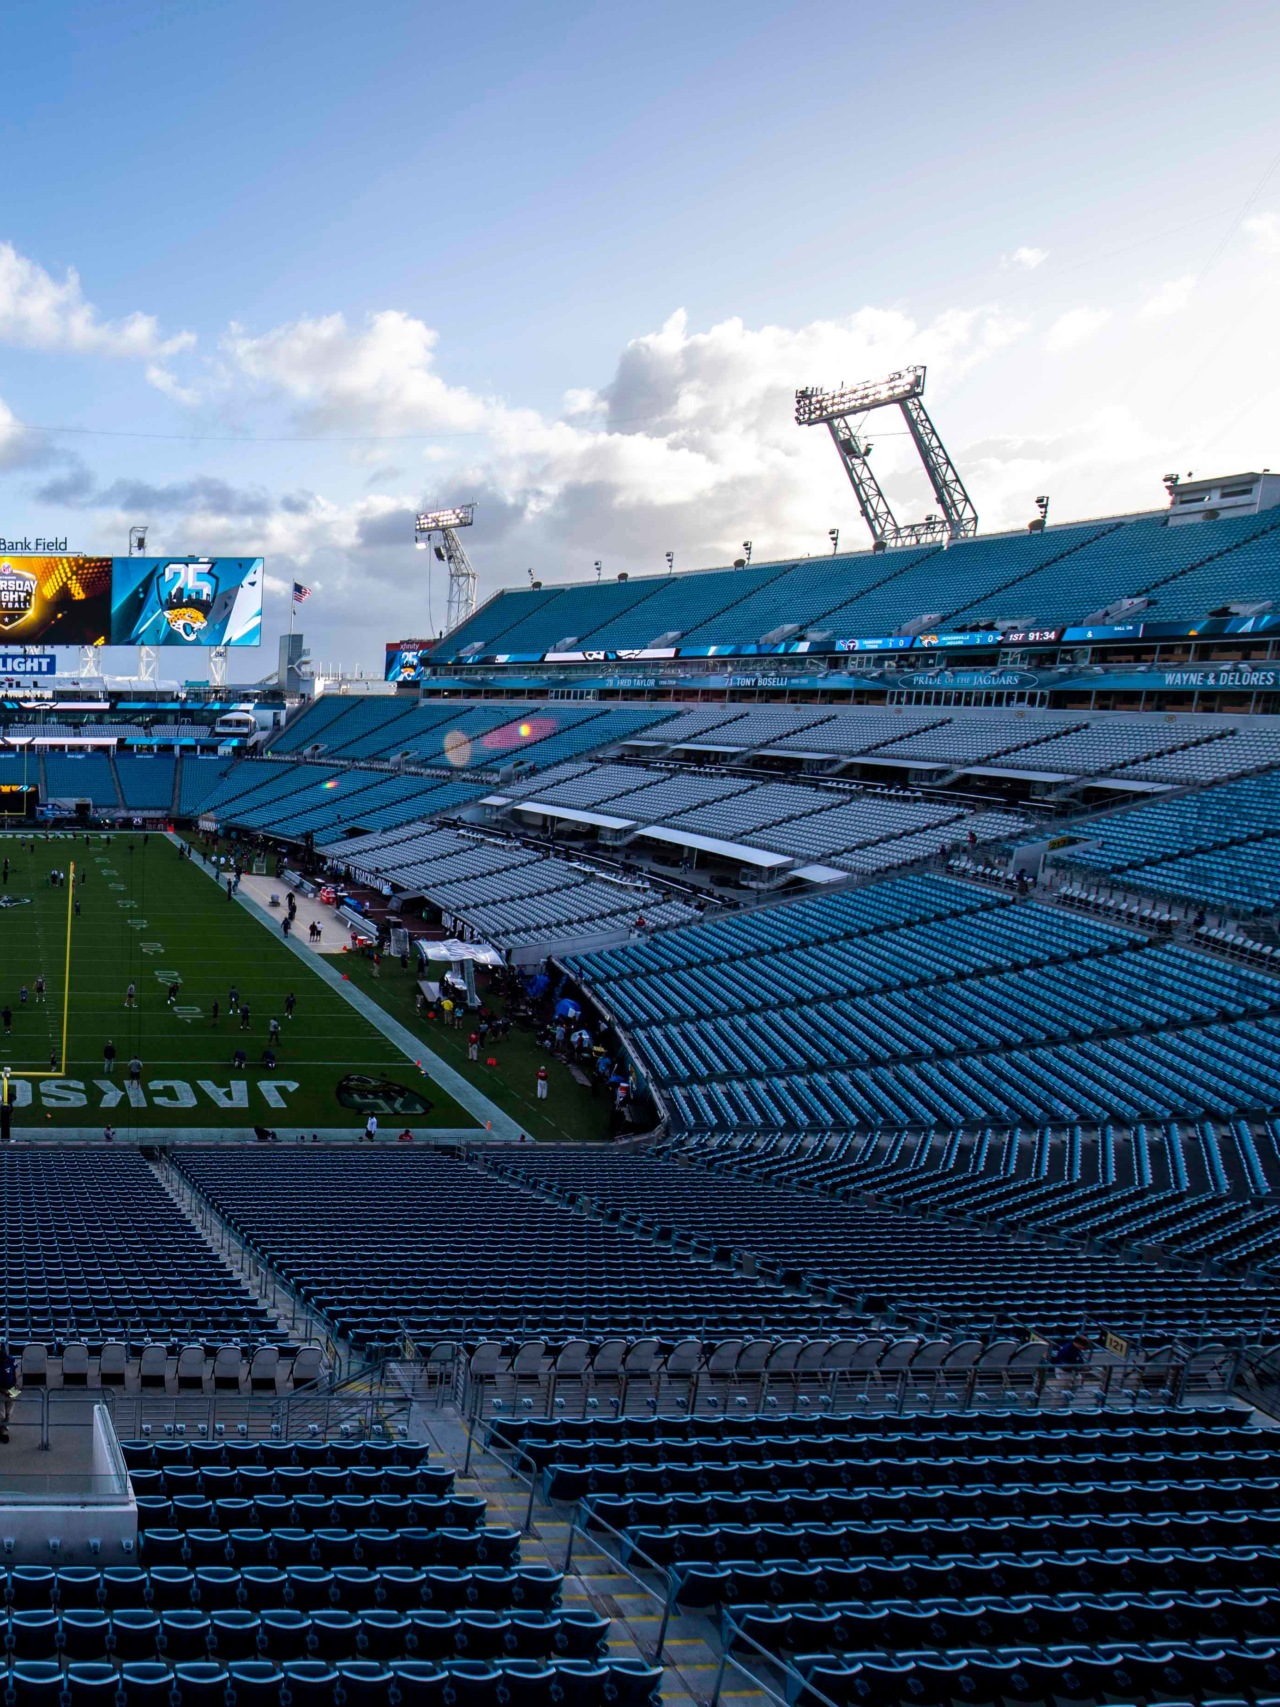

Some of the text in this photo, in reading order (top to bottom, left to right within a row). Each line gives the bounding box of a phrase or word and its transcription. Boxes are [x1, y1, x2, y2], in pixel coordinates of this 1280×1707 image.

[35, 537, 67, 551] Field
[165, 563, 213, 603] 25
[987, 634, 994, 642] 0
[1009, 631, 1056, 641] 1ST 91:34
[400, 643, 420, 651] xfinity
[898, 639, 904, 647] 0
[606, 679, 613, 687] 28
[617, 679, 633, 687] FRED
[633, 679, 655, 687] TAYLOR
[724, 678, 733, 687] 71
[736, 678, 756, 687] TONY
[757, 677, 788, 686] BOSELLI
[913, 675, 942, 685] PRIDE
[973, 675, 1019, 686] JAGUARS
[1164, 672, 1275, 685] WAYNE & DELORES
[139, 942, 165, 954] 30
[153, 970, 183, 984] 20
[172, 1006, 205, 1019] 10
[1109, 1337, 1124, 1352] 121
